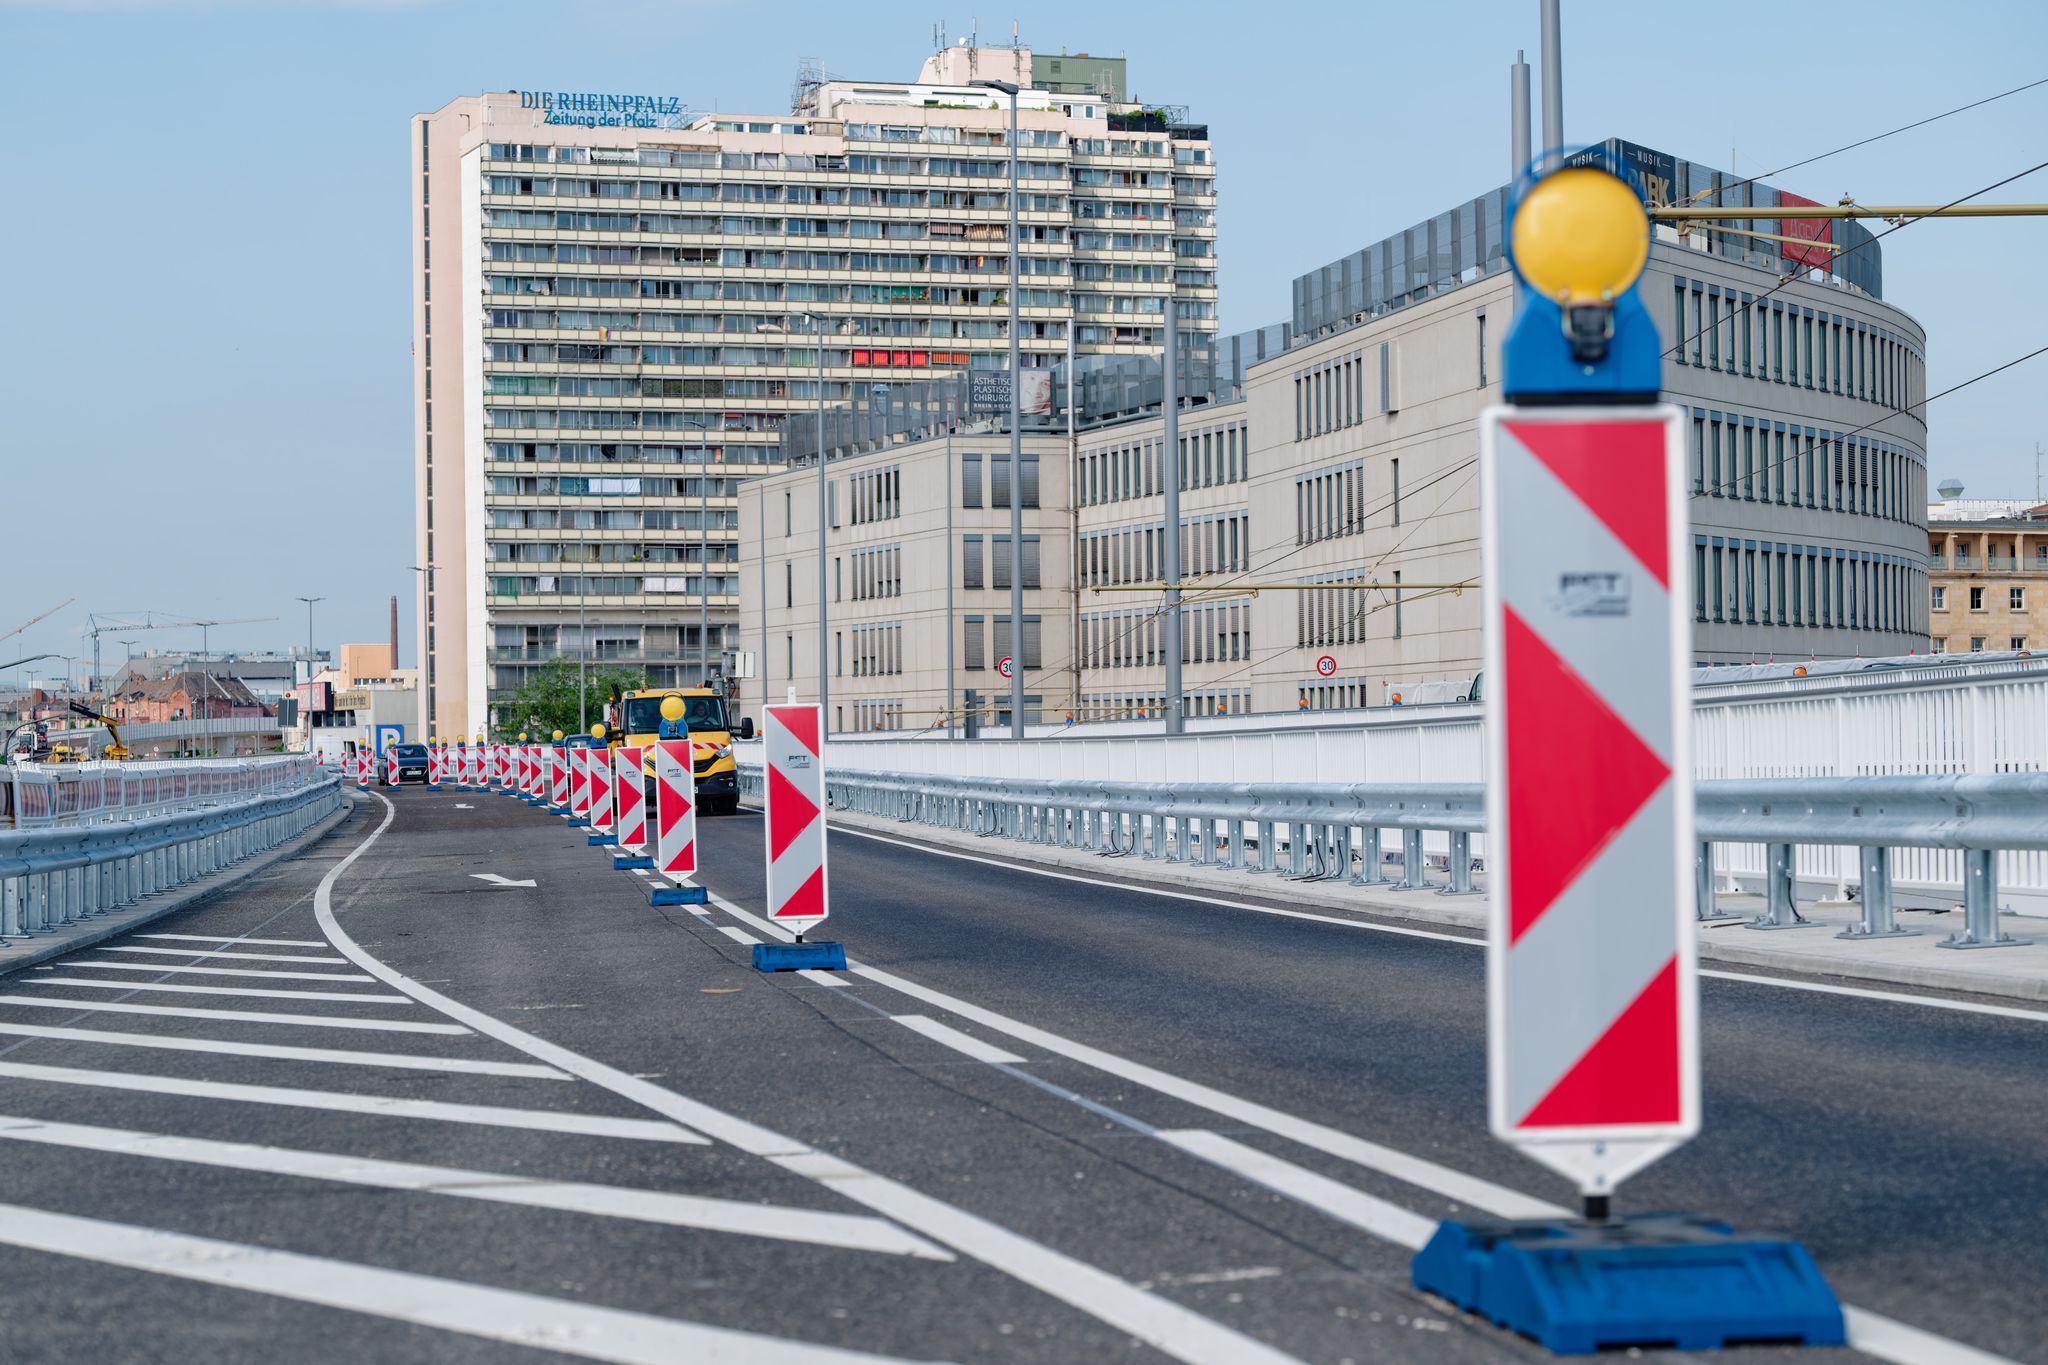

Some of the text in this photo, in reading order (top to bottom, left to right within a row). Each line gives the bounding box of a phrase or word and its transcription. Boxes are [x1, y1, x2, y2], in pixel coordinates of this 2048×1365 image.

[521, 91, 680, 114] DIE RHEINPFALZ
[543, 110, 657, 129] Zeitung der Pfalz
[1572, 151, 1594, 167] MUSIK
[1637, 150, 1661, 168] MUSIK
[1626, 167, 1670, 208] PARK
[973, 385, 1012, 394] PLASTISCH
[973, 393, 1012, 402] CHIRURGI
[1321, 660, 1334, 671] 30
[381, 727, 401, 756] P
